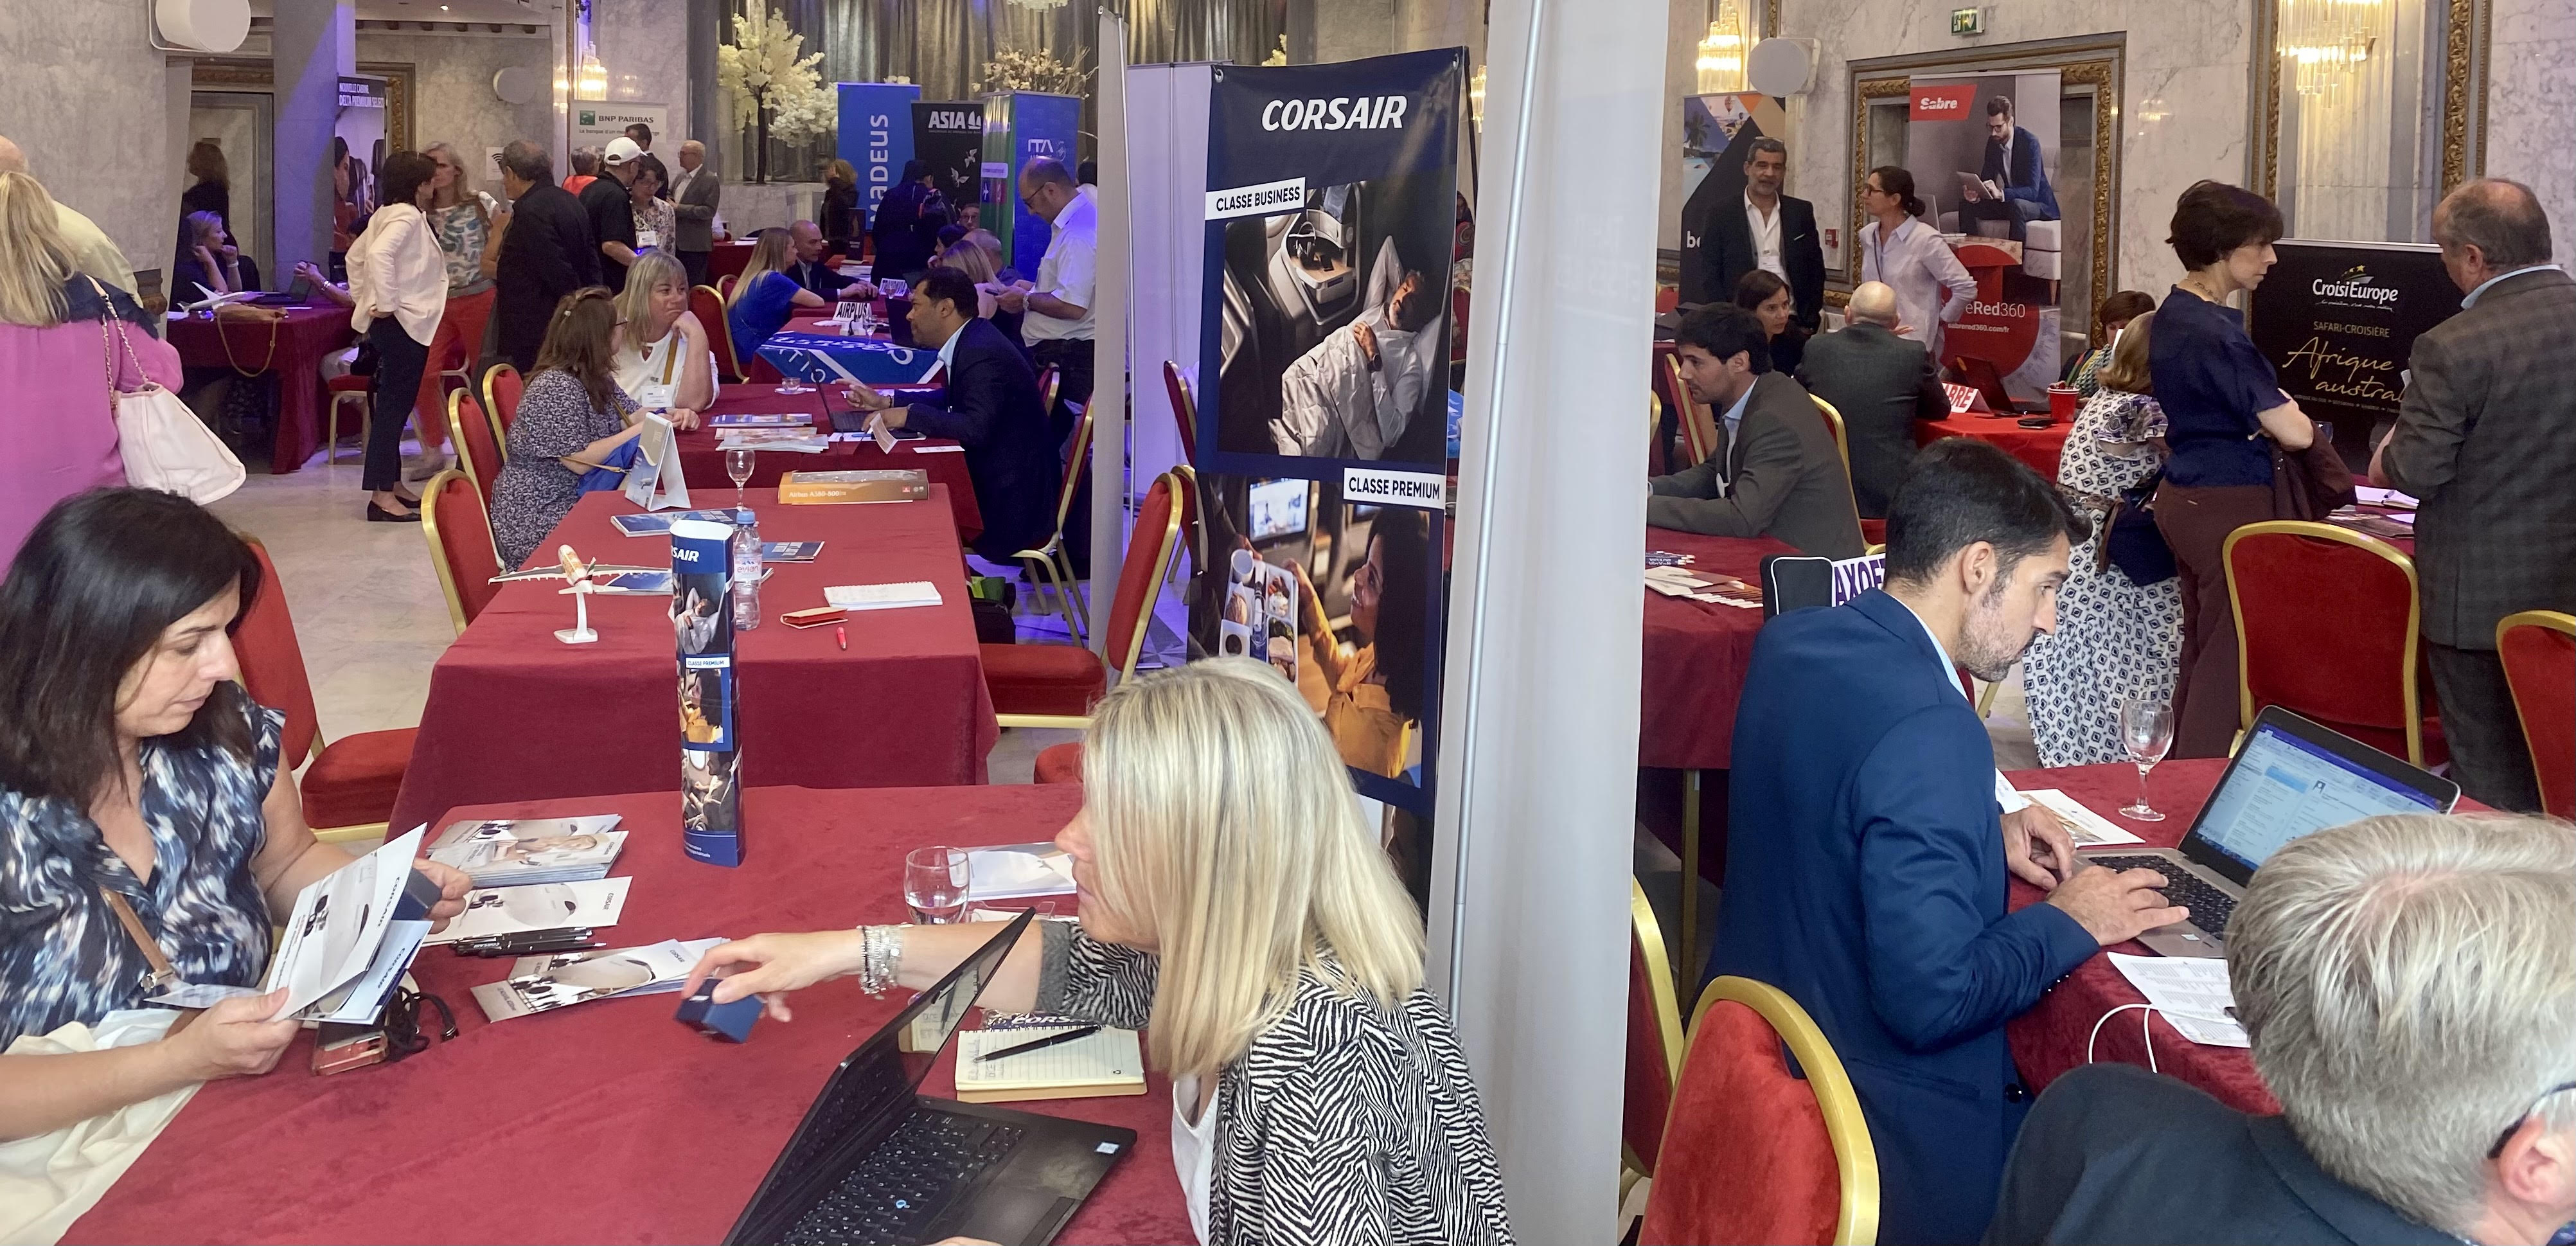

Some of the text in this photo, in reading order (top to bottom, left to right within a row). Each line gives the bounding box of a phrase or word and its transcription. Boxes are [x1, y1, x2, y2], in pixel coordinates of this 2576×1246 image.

[339, 95, 351, 106] DELTA
[1920, 97, 1958, 110] Sabre
[928, 111, 966, 129] ASIA
[1262, 96, 1407, 131] CORSAIR
[1028, 138, 1054, 154] ITA
[1216, 186, 1300, 211] CLASSE BUSINESS
[2313, 278, 2399, 305] CroisiEurope
[836, 303, 867, 320] AIRPLUS
[2313, 321, 2391, 338] SAFARI-CROISIÈRE
[2282, 337, 2395, 383] Afrique
[1944, 384, 1975, 408] BRE
[1349, 477, 1440, 500] CLASSE PREMIUM
[737, 565, 759, 573] evian
